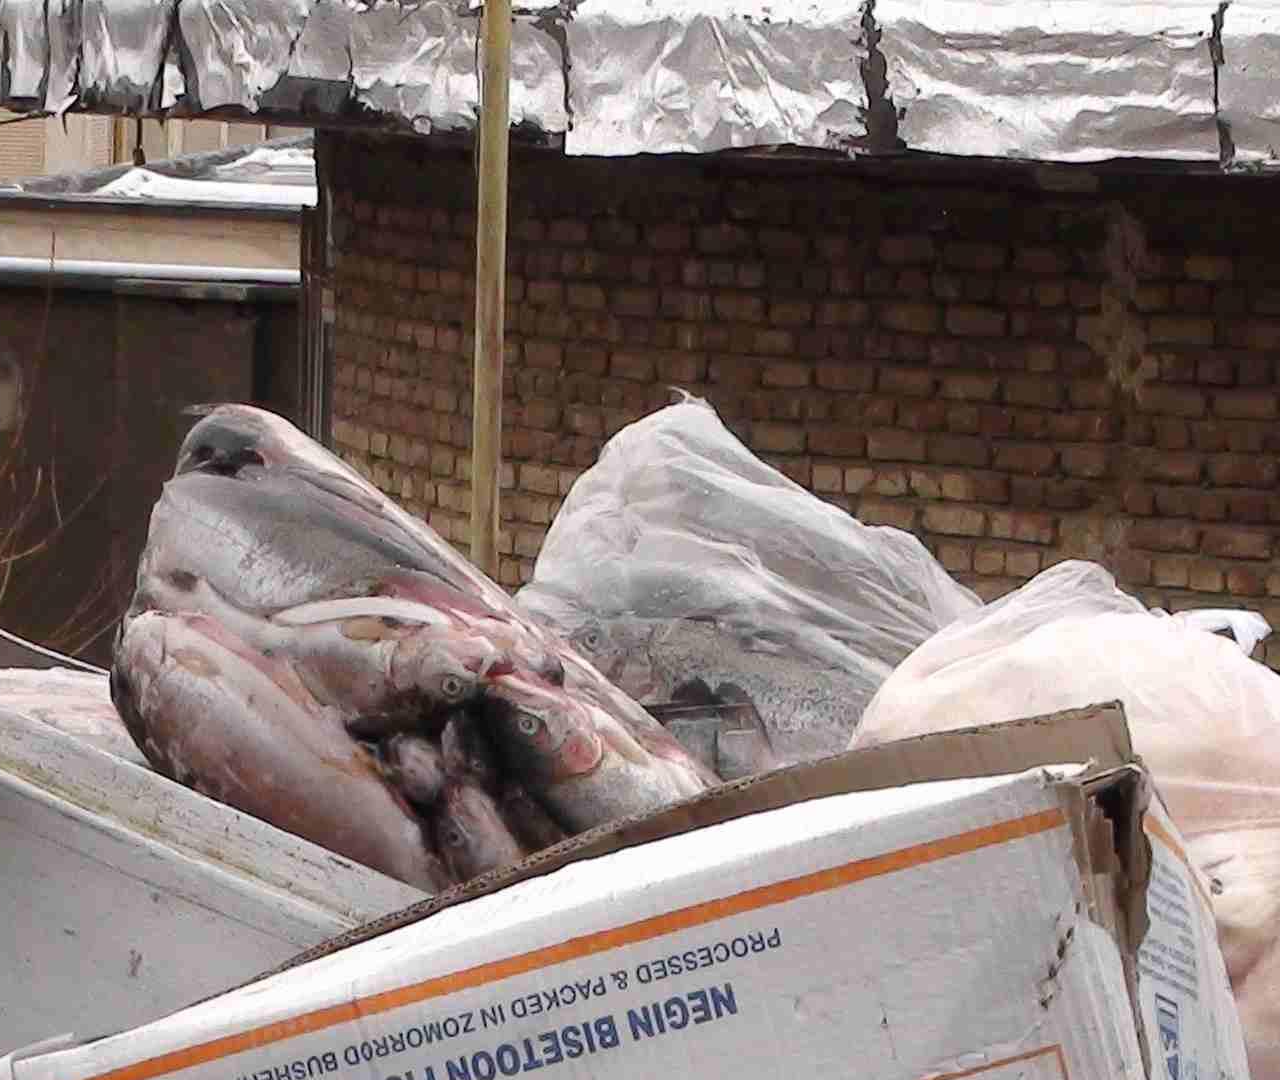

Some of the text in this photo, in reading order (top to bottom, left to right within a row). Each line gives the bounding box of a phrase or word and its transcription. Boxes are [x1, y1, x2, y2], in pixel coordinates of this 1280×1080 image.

[636, 927, 782, 984] PROCESSED
[513, 976, 606, 1018] PACKED
[611, 970, 629, 989] &
[482, 1005, 505, 1028] IN
[627, 983, 739, 1041] NEGIN
